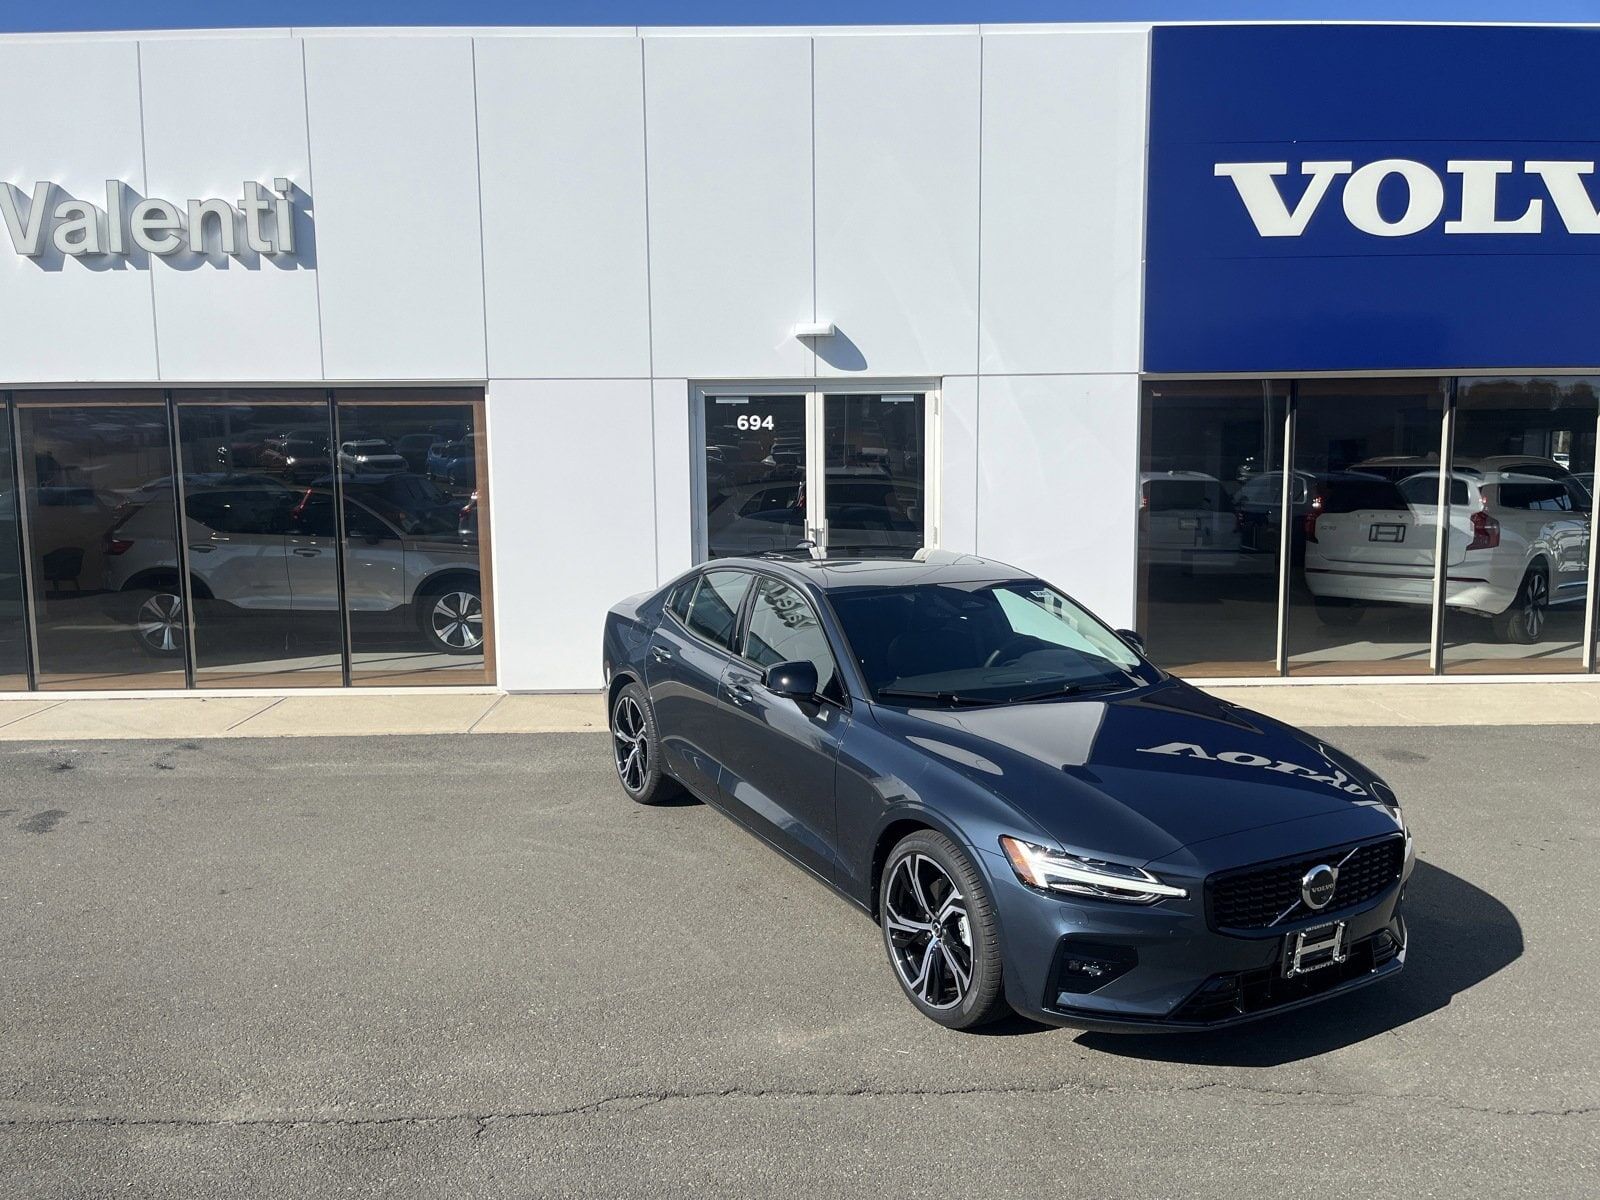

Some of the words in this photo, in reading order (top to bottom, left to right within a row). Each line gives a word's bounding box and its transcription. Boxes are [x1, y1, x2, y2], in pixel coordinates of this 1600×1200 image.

[0, 178, 293, 256] Valenti
[1214, 159, 1600, 237] VOLV
[737, 415, 774, 430] 694
[1311, 883, 1334, 893] VOLVO
